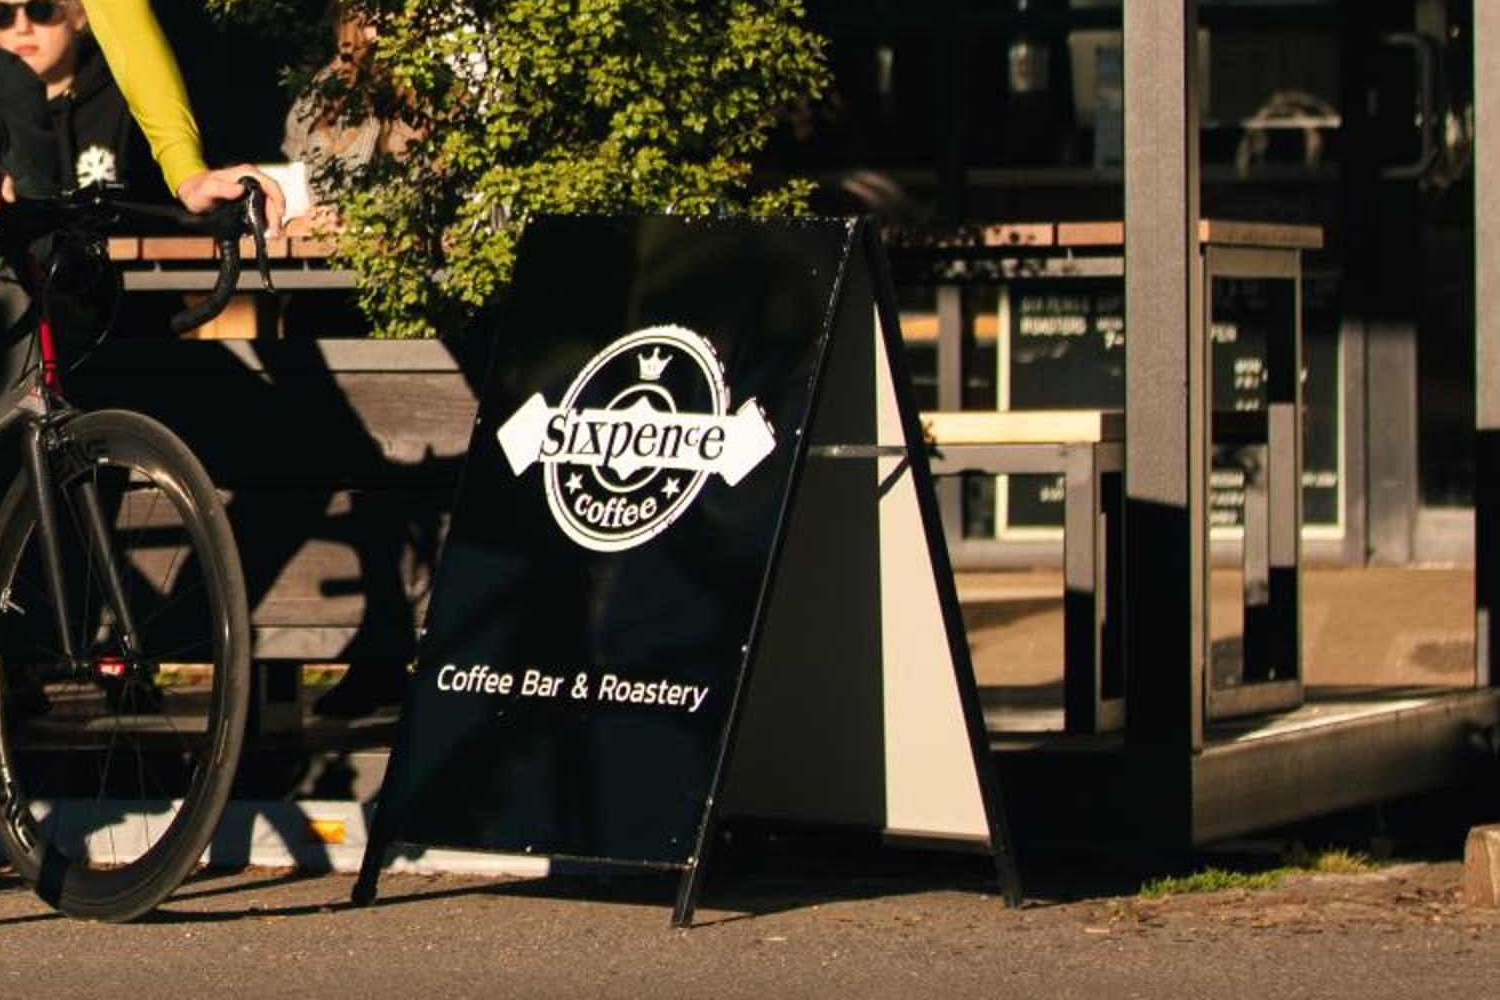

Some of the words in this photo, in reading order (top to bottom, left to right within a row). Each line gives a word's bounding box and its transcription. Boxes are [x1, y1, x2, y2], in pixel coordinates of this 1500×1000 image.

[538, 407, 726, 468] Sixpence
[436, 664, 513, 694] Coffee
[520, 669, 564, 697] Bar
[571, 672, 589, 699] &
[597, 674, 709, 713] Roastery
